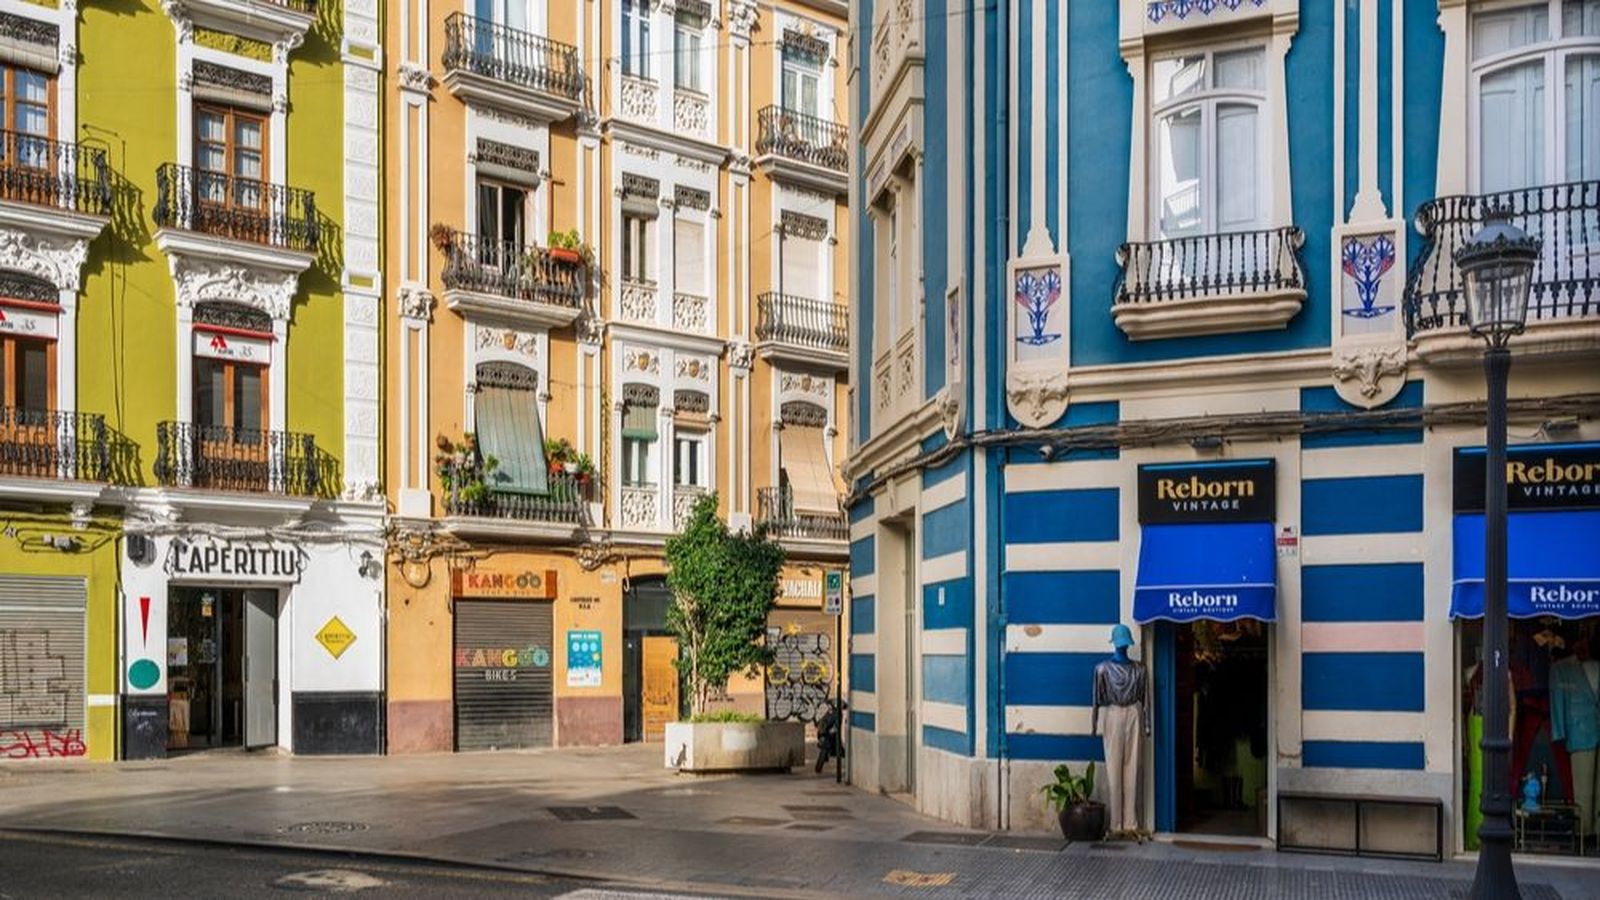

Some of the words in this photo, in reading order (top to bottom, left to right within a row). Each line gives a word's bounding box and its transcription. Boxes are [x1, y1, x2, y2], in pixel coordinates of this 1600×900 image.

[1157, 475, 1254, 500] Reborn
[1523, 484, 1600, 497] VINTAGE
[1172, 499, 1240, 512] VINTAGE
[174, 545, 295, 576] L'APERITIU
[468, 572, 541, 589] KANGOO
[1169, 591, 1238, 607] Reborn
[455, 645, 550, 668] KANGOO
[485, 669, 517, 681] BIKES
